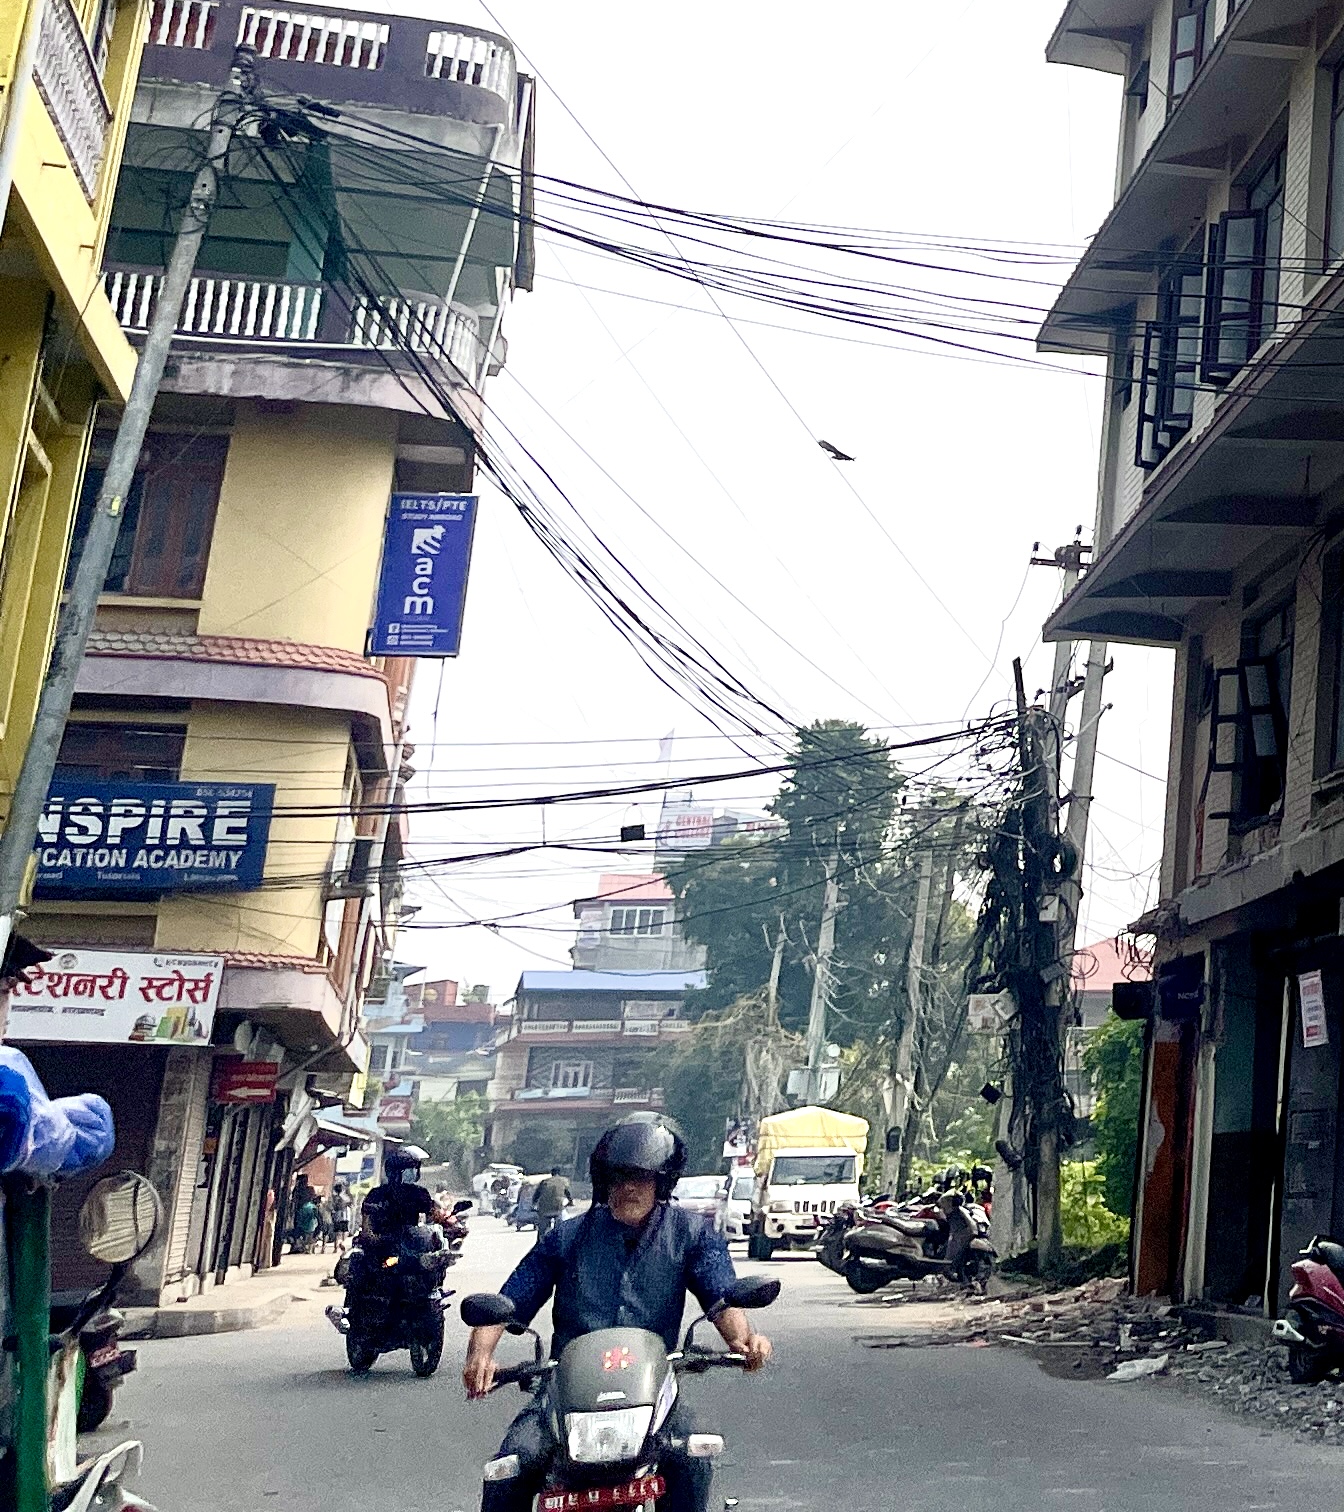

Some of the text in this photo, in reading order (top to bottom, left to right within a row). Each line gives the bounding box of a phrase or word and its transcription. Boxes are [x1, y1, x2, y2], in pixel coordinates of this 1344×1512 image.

[400, 498, 468, 511] IELTS/PTE
[38, 797, 251, 846] NSPIRE
[132, 850, 243, 870] ACADEMY
